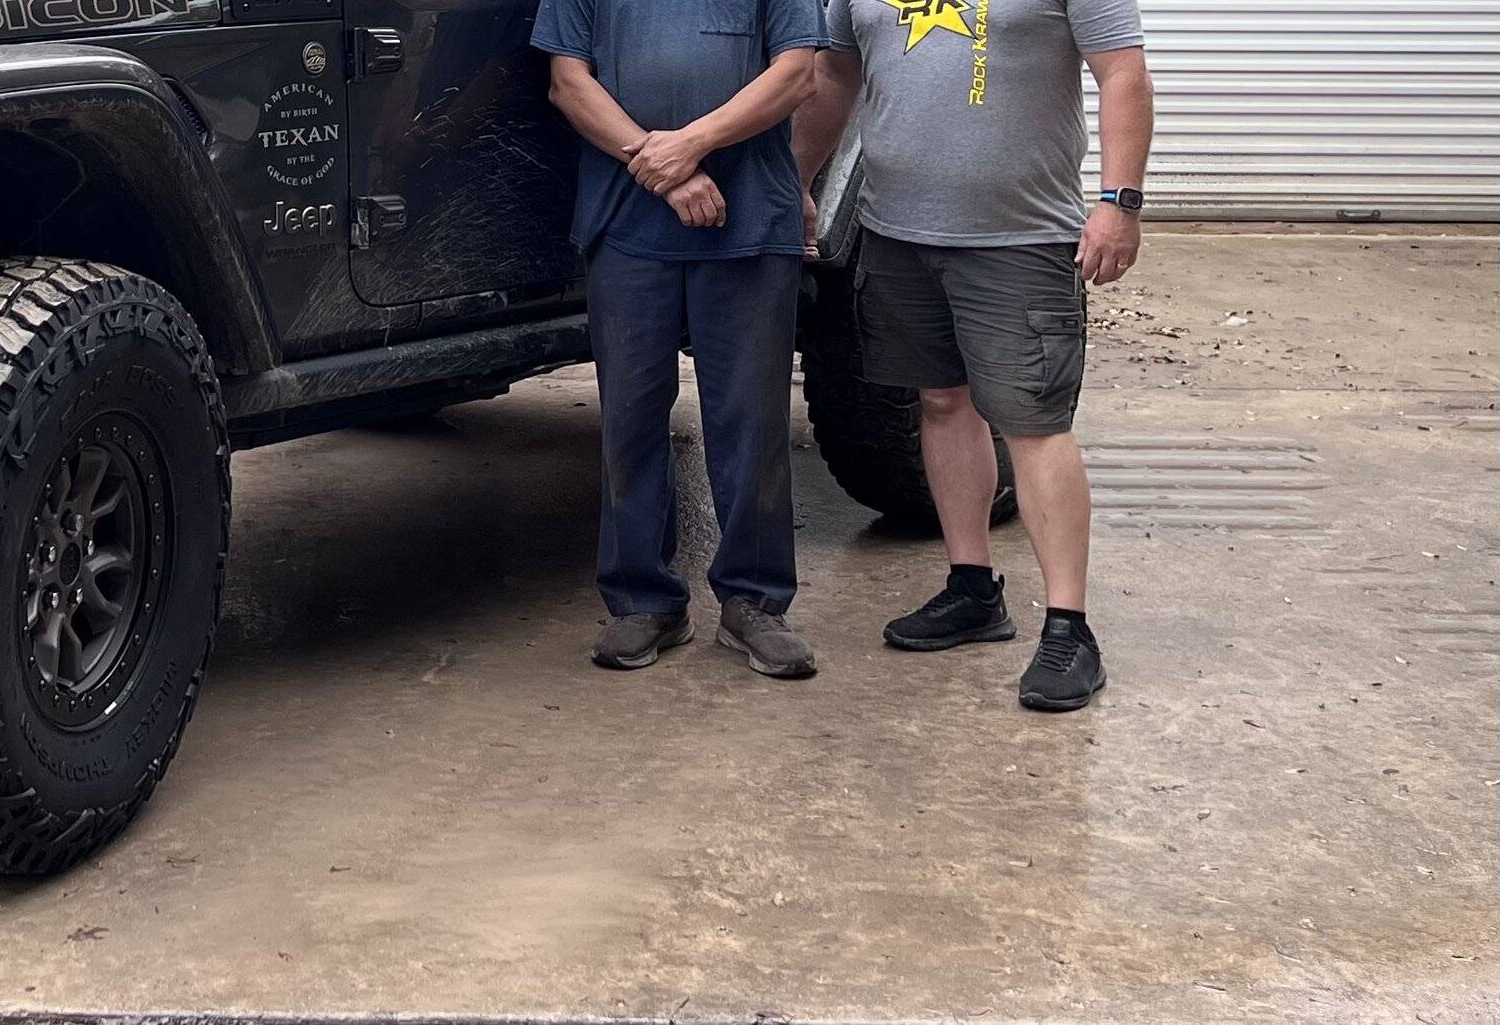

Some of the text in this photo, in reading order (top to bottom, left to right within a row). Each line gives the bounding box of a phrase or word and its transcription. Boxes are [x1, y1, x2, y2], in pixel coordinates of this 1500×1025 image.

[967, 53, 987, 107] ROCK
[263, 82, 334, 113] AMERICAN
[280, 107, 318, 119] BY BIRTH
[258, 124, 340, 148] TEXAN
[266, 157, 334, 186] GRACE OF GOD
[286, 154, 316, 165] BY THE
[263, 200, 338, 237] Jeep
